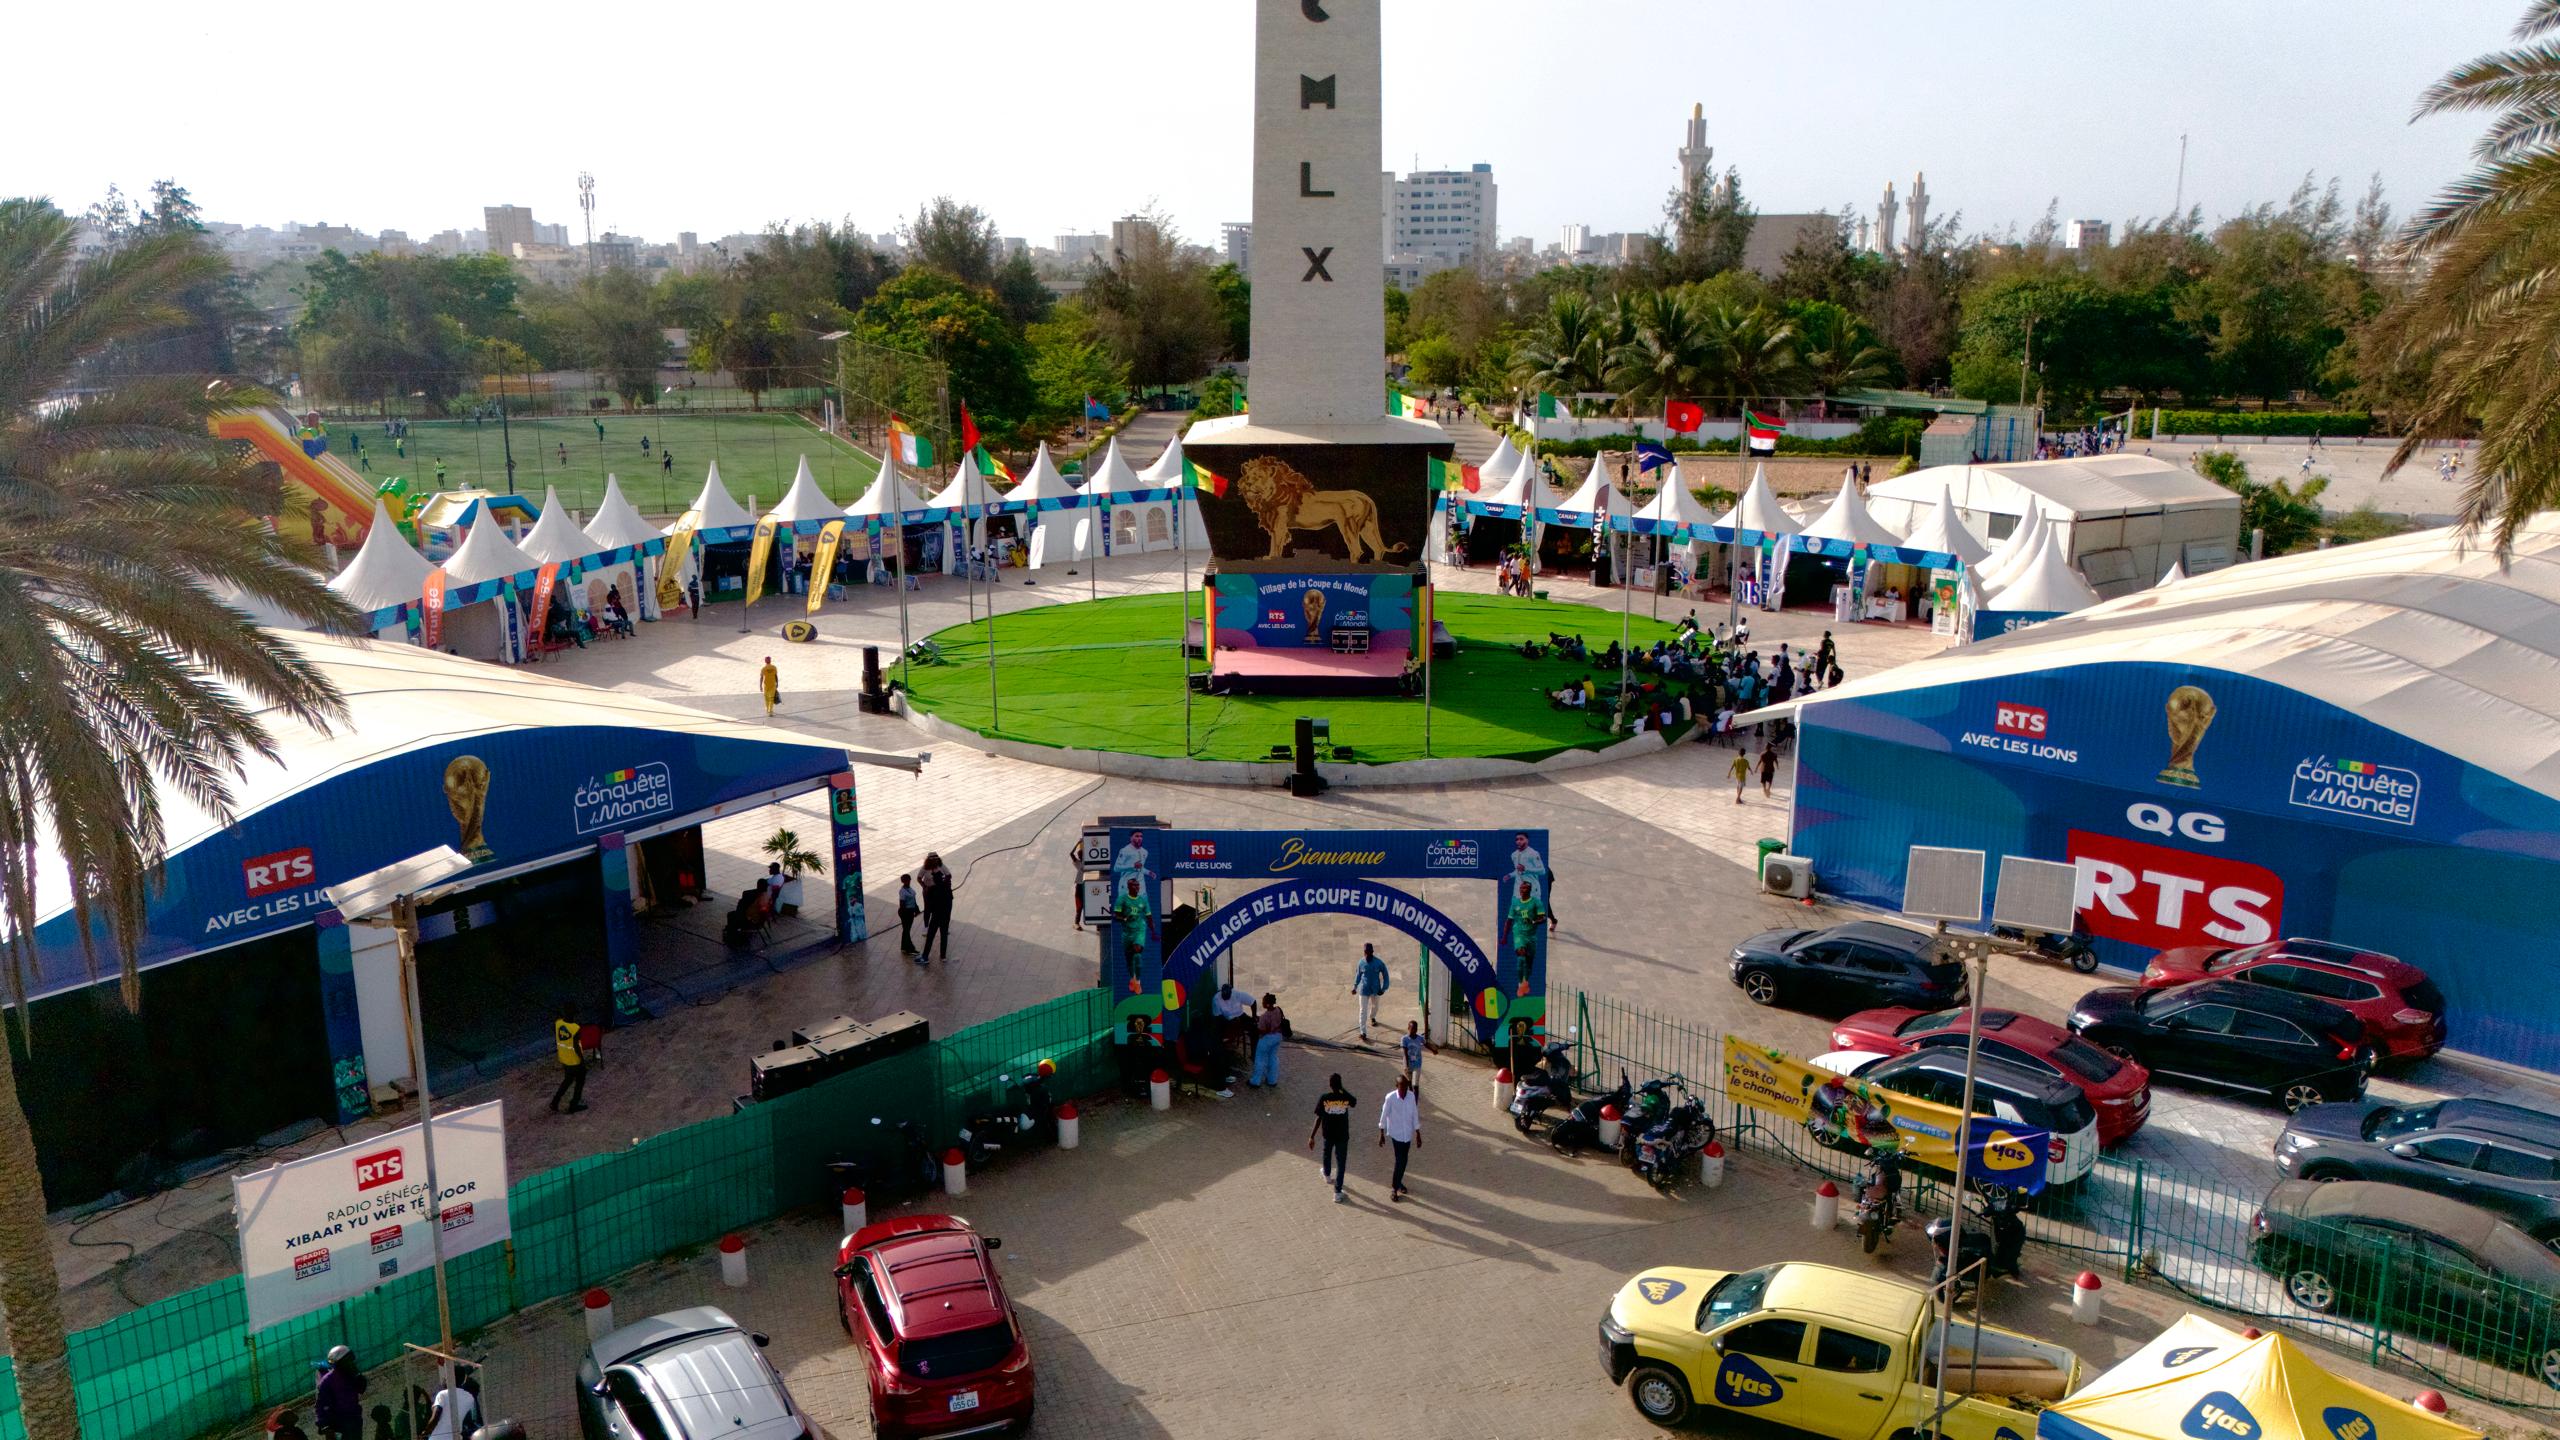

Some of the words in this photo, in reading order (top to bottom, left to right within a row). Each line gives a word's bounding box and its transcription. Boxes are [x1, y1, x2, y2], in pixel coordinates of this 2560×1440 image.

[1259, 582, 1286, 596] Village
[1288, 580, 1297, 589] de
[1299, 579, 1306, 588] la
[1308, 578, 1331, 590] Coupe
[1333, 581, 1342, 590] du
[1344, 582, 1368, 597] Monde
[1268, 612, 1286, 621] RTS
[1997, 708, 2045, 732] RTS
[1960, 732, 2000, 749] AVEC
[2003, 739, 2029, 754] LES
[2032, 744, 2078, 763] LIONS
[575, 773, 666, 808] Conquête
[2296, 763, 2414, 798] Conquête
[599, 791, 668, 823] Monde
[2318, 787, 2410, 818] Monde
[2126, 803, 2225, 842] QG
[1191, 845, 1215, 855] RTS
[1269, 837, 1386, 872] Bienvenue
[1427, 844, 1476, 857] Conquête
[1438, 856, 1476, 866] Monde
[247, 855, 312, 889] RTS
[1210, 862, 1232, 870] LIONS
[205, 905, 260, 933] AVEC
[265, 895, 300, 917] LES
[304, 886, 333, 907] LIO
[2075, 856, 2272, 945] RTS
[1190, 908, 1252, 967] VILLAGE
[1252, 895, 1274, 916] DE
[1278, 890, 1300, 909] LA
[1304, 888, 1361, 906] COUPE
[1364, 892, 1388, 911] DU
[1391, 898, 1447, 942] MONDE
[1445, 935, 1479, 974] 2026
[1730, 1075, 1741, 1086] le
[1743, 1080, 1800, 1106] champion
[1732, 1064, 1759, 1080] c'est
[1761, 1071, 1777, 1086] toi
[1991, 1143, 2026, 1161] yas
[358, 1156, 401, 1185] RTS
[327, 1201, 372, 1222] RADIO
[376, 1182, 430, 1207] SÉNÉGA
[286, 1223, 343, 1249] XIBAAR
[348, 1215, 369, 1229] YU
[302, 1248, 328, 1261] RADIO
[296, 1270, 309, 1278] FM
[1725, 1370, 1772, 1398] yas
[2201, 1403, 2252, 1436] yas
